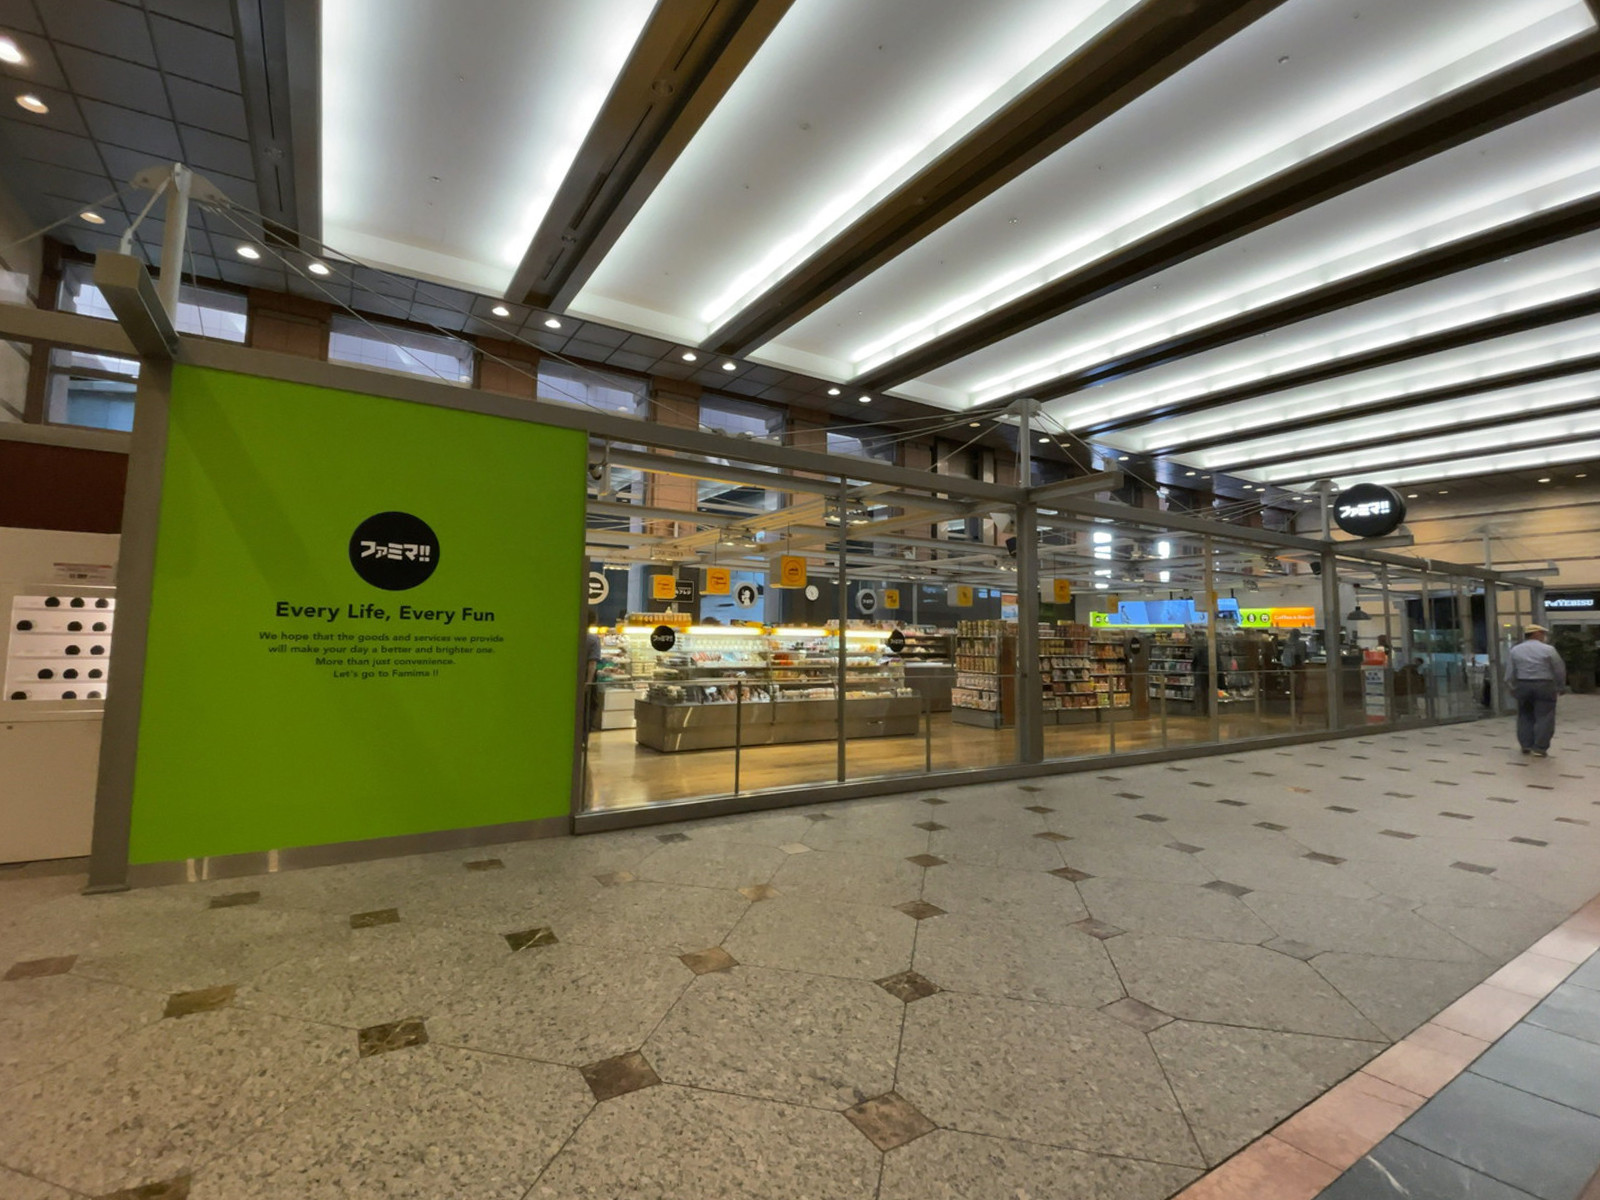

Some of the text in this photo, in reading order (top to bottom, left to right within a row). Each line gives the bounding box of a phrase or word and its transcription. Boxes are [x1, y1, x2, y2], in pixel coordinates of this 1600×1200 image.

[1339, 500, 1391, 518] ファミマ!!
[360, 540, 431, 562] ファミマ!!
[275, 601, 495, 625] Every Life, Every Fun
[259, 631, 278, 640] We
[280, 631, 309, 642] hope
[312, 632, 334, 641] that
[337, 632, 355, 641] the
[357, 633, 390, 643] goods
[392, 633, 411, 641] and
[414, 634, 451, 642] services
[470, 634, 504, 644] provide
[268, 644, 288, 653] will
[290, 644, 319, 653] make
[322, 646, 347, 655] your
[350, 645, 369, 655] day
[380, 645, 411, 654] better
[414, 645, 433, 654] and
[435, 646, 473, 656] brighter
[315, 657, 457, 668] More than just convenience.
[332, 670, 359, 679] Let's
[361, 671, 375, 680] go
[378, 670, 389, 678] to
[391, 669, 431, 678] Famima
